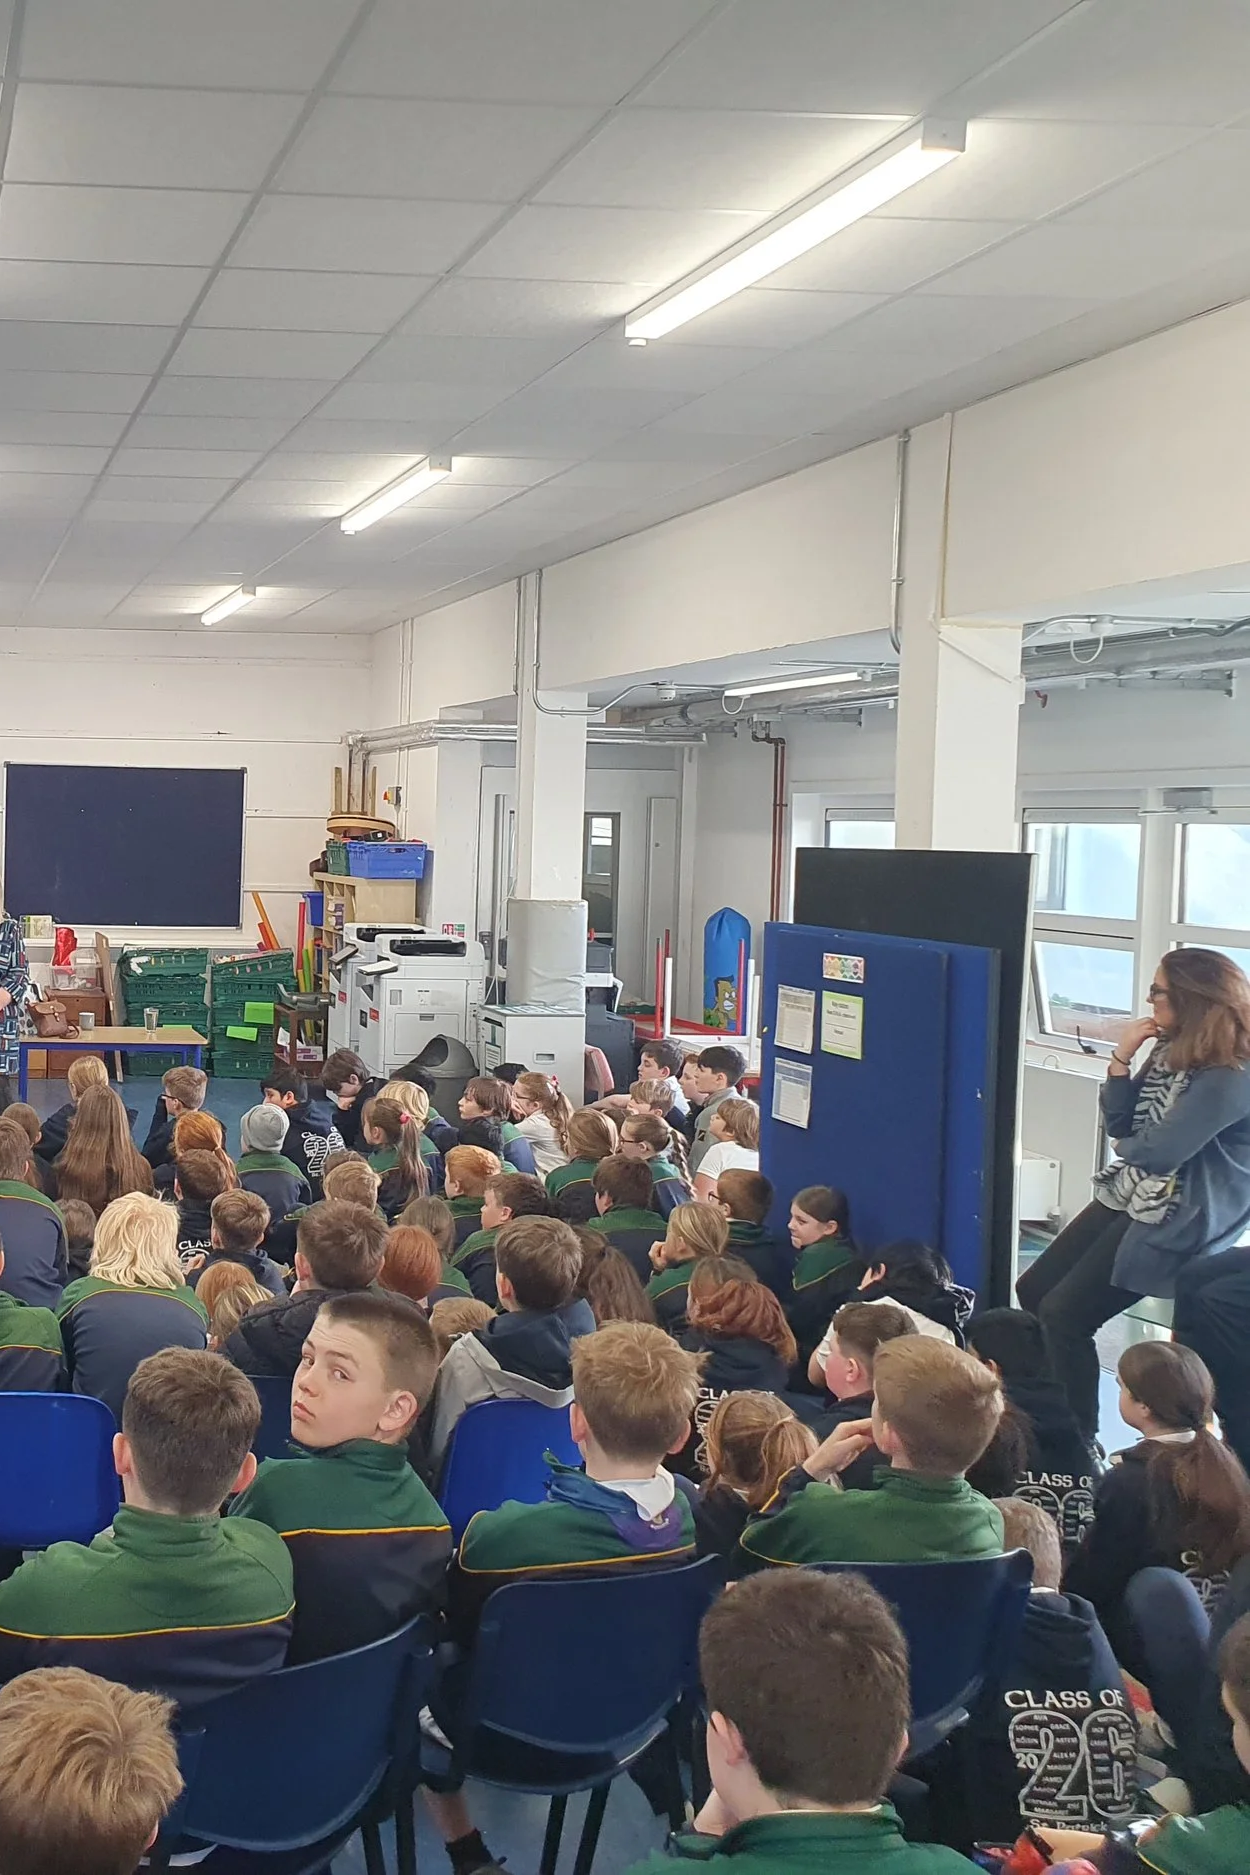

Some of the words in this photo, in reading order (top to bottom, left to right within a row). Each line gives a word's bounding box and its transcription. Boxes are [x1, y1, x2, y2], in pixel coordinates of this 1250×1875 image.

[1004, 1689, 1092, 1709] CLASS
[1099, 1689, 1124, 1707] OF
[1015, 1753, 1038, 1769] 20
